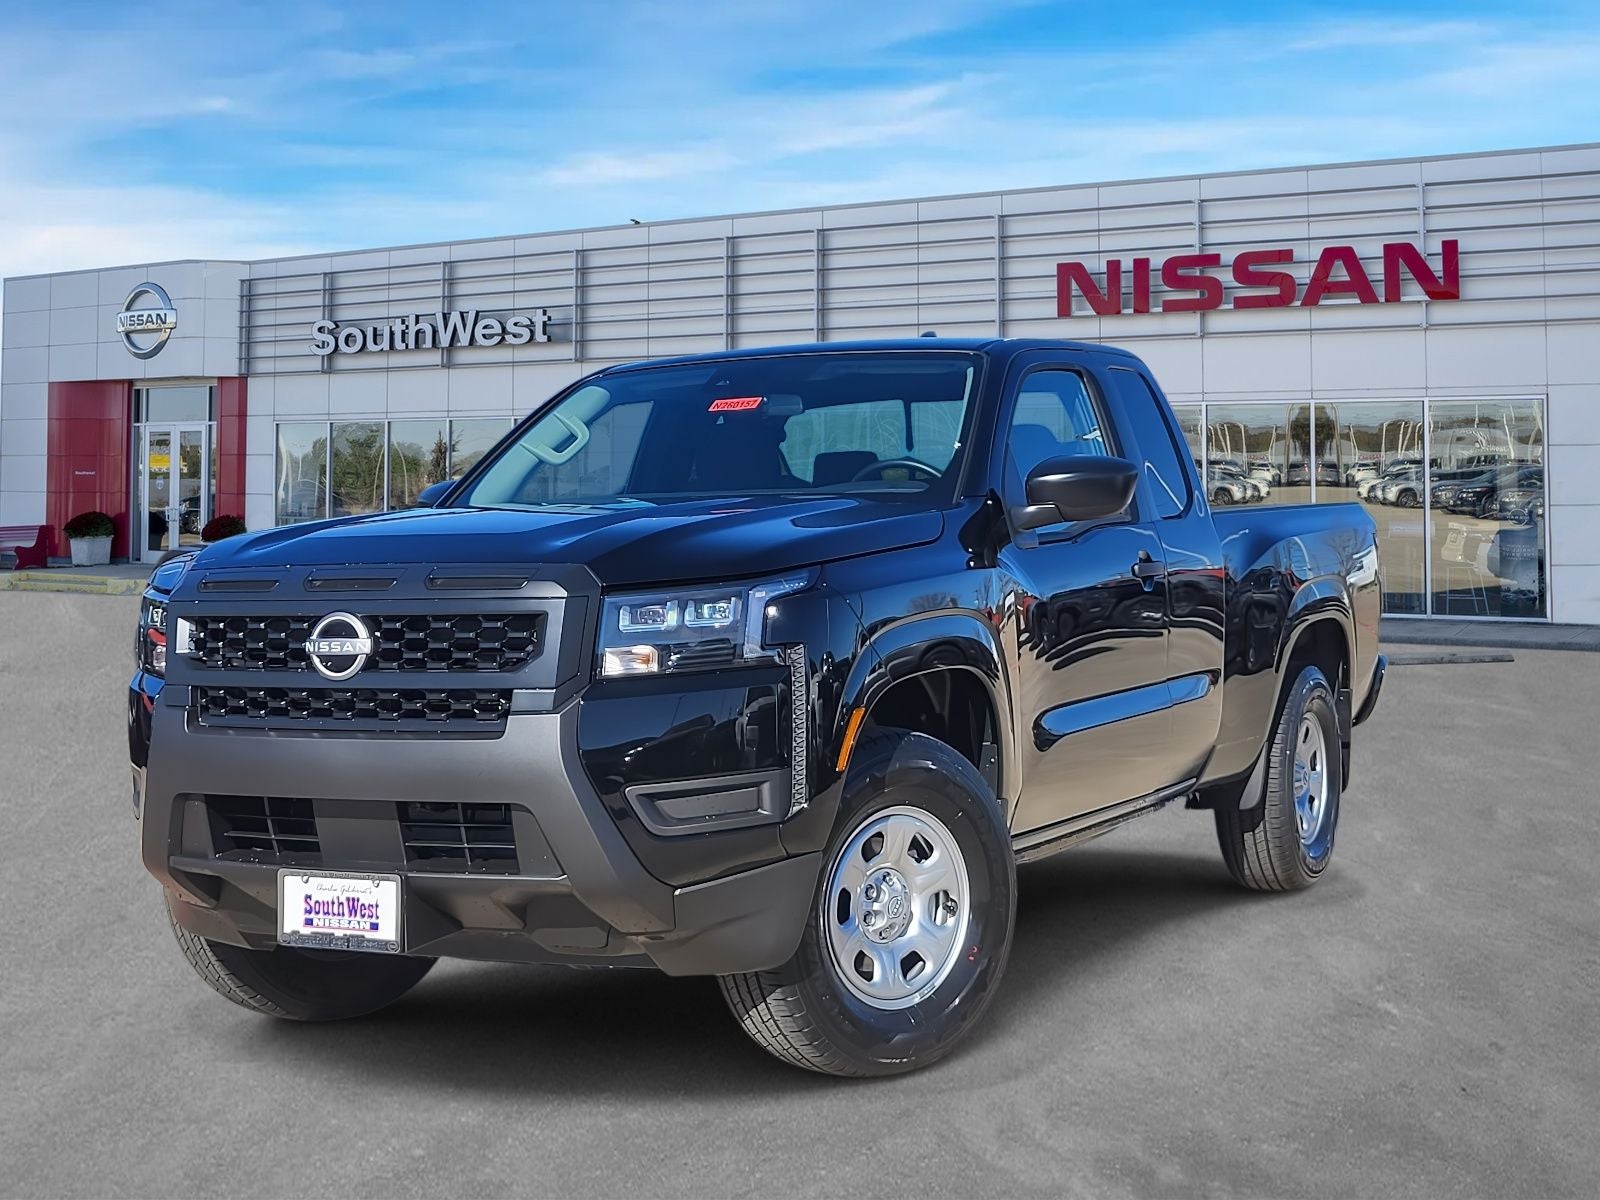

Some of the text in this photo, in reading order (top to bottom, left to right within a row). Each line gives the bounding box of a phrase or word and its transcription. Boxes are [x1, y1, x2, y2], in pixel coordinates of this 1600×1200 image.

[1057, 239, 1461, 318] NISSAN
[119, 312, 168, 328] NISSAN
[309, 308, 551, 356] SouthWest
[712, 400, 758, 410] N260157
[305, 641, 368, 652] NISSAN
[313, 918, 371, 930] NISSAN
